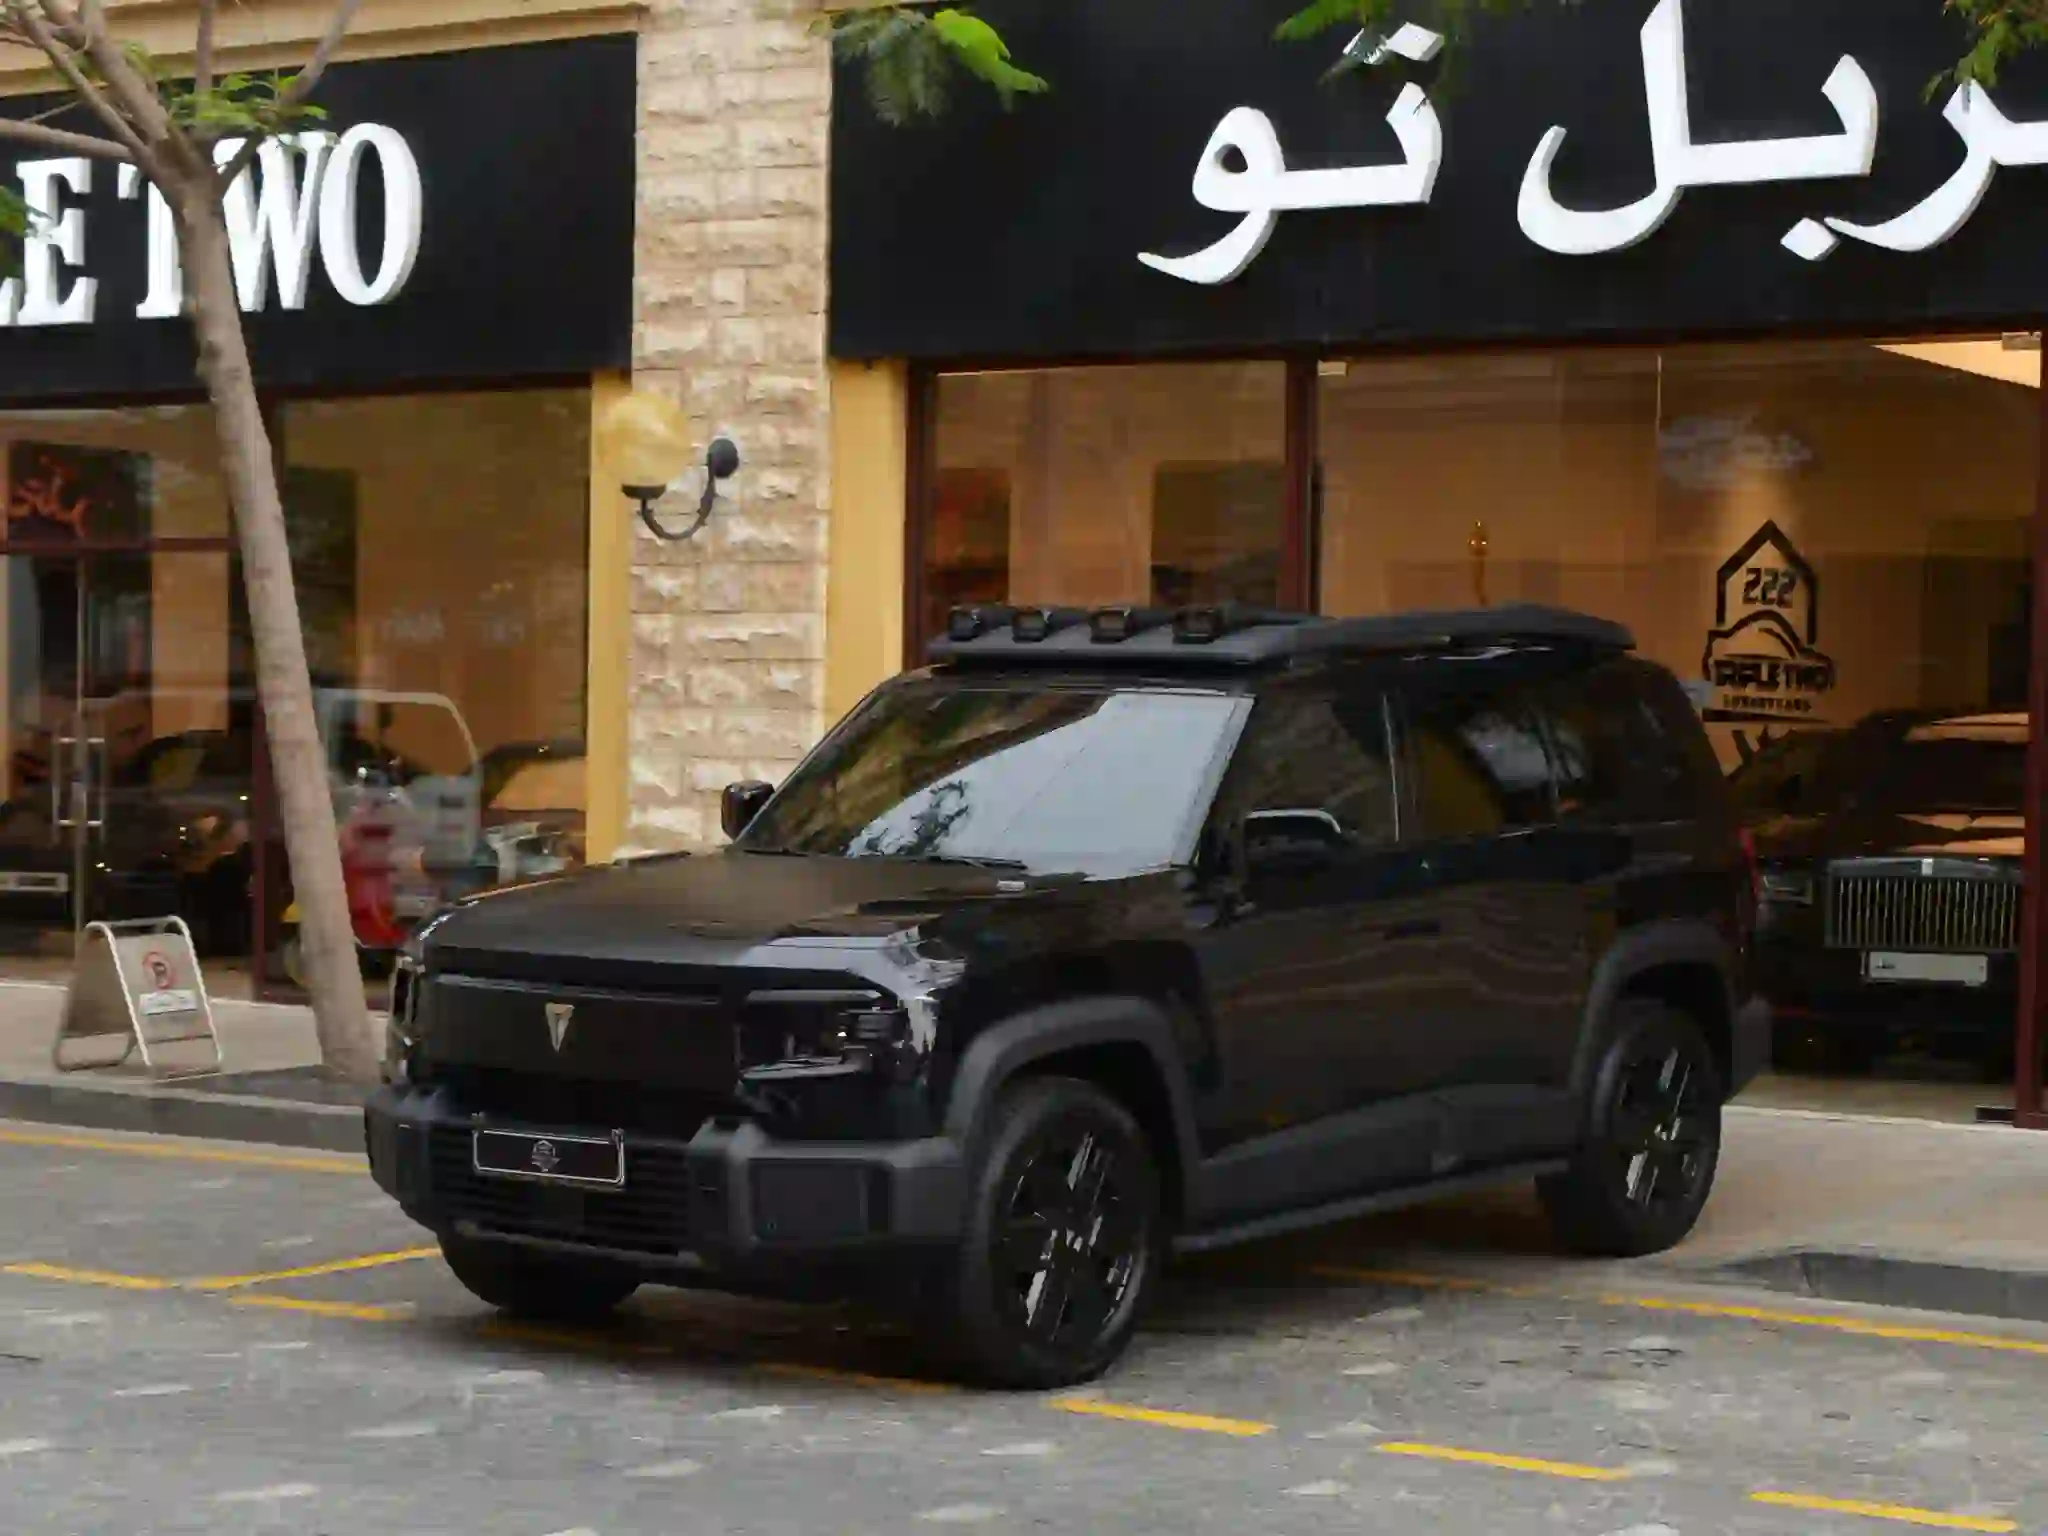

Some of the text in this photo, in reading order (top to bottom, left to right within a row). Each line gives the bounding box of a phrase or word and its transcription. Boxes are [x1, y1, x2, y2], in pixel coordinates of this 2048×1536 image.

[1137, 0, 2048, 285] ربل تو
[0, 157, 98, 326] E
[1742, 567, 1796, 609] 222
